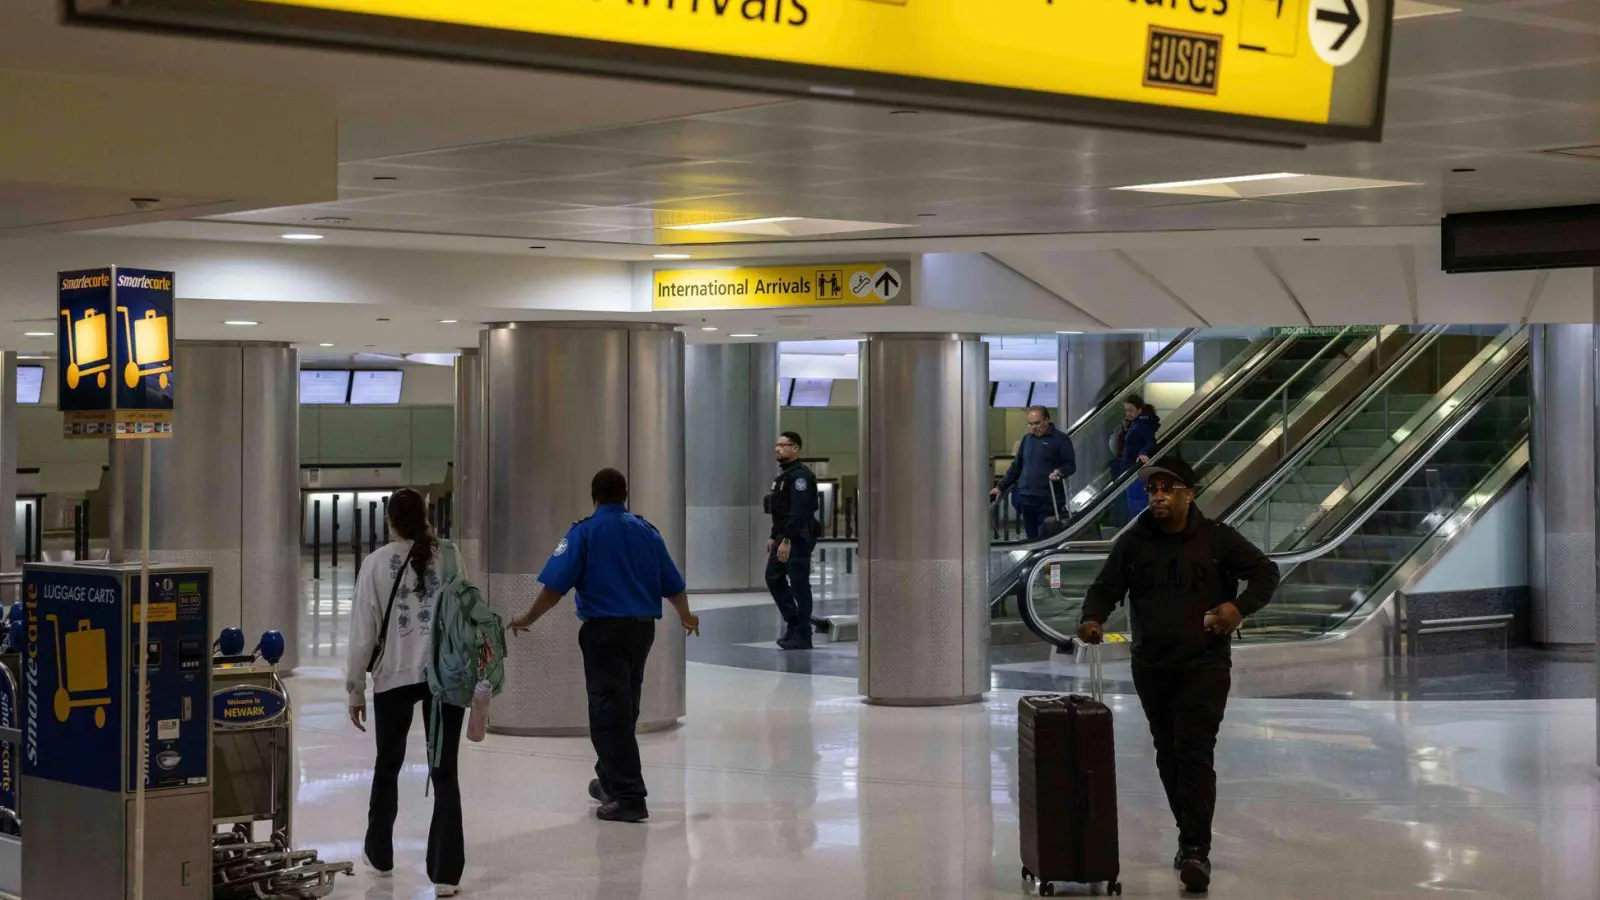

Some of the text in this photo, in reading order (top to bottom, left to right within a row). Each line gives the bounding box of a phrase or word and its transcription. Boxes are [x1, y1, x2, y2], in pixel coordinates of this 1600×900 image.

[1158, 36, 1207, 84] USO
[657, 276, 811, 297] International Arrivals
[44, 584, 115, 604] LUGGAGE CARTS
[223, 706, 266, 718] NEWARK
[226, 698, 254, 706] Welcome
